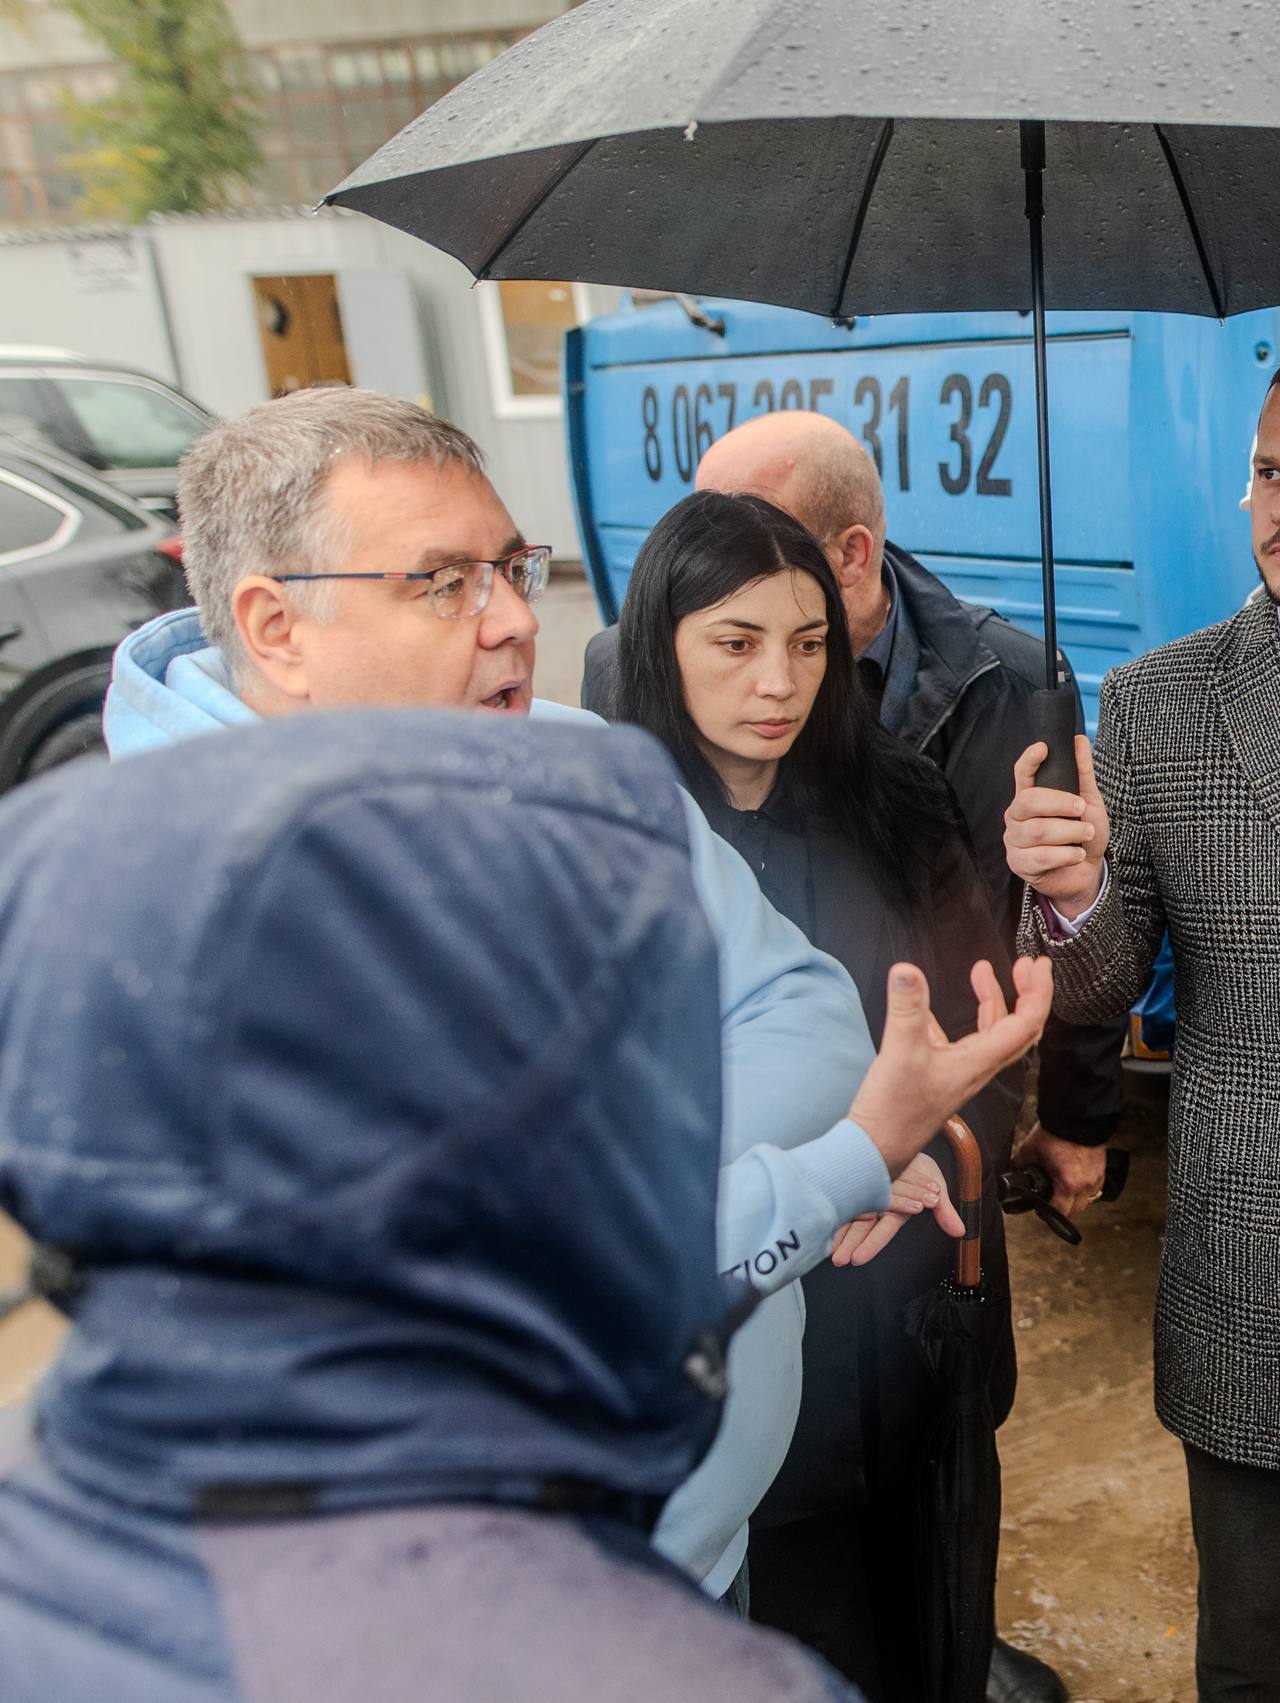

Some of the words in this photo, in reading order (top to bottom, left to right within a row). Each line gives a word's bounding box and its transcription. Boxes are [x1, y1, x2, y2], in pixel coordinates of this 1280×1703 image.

[643, 386, 661, 482] 8
[854, 375, 910, 492] 31
[938, 372, 1012, 496] 32
